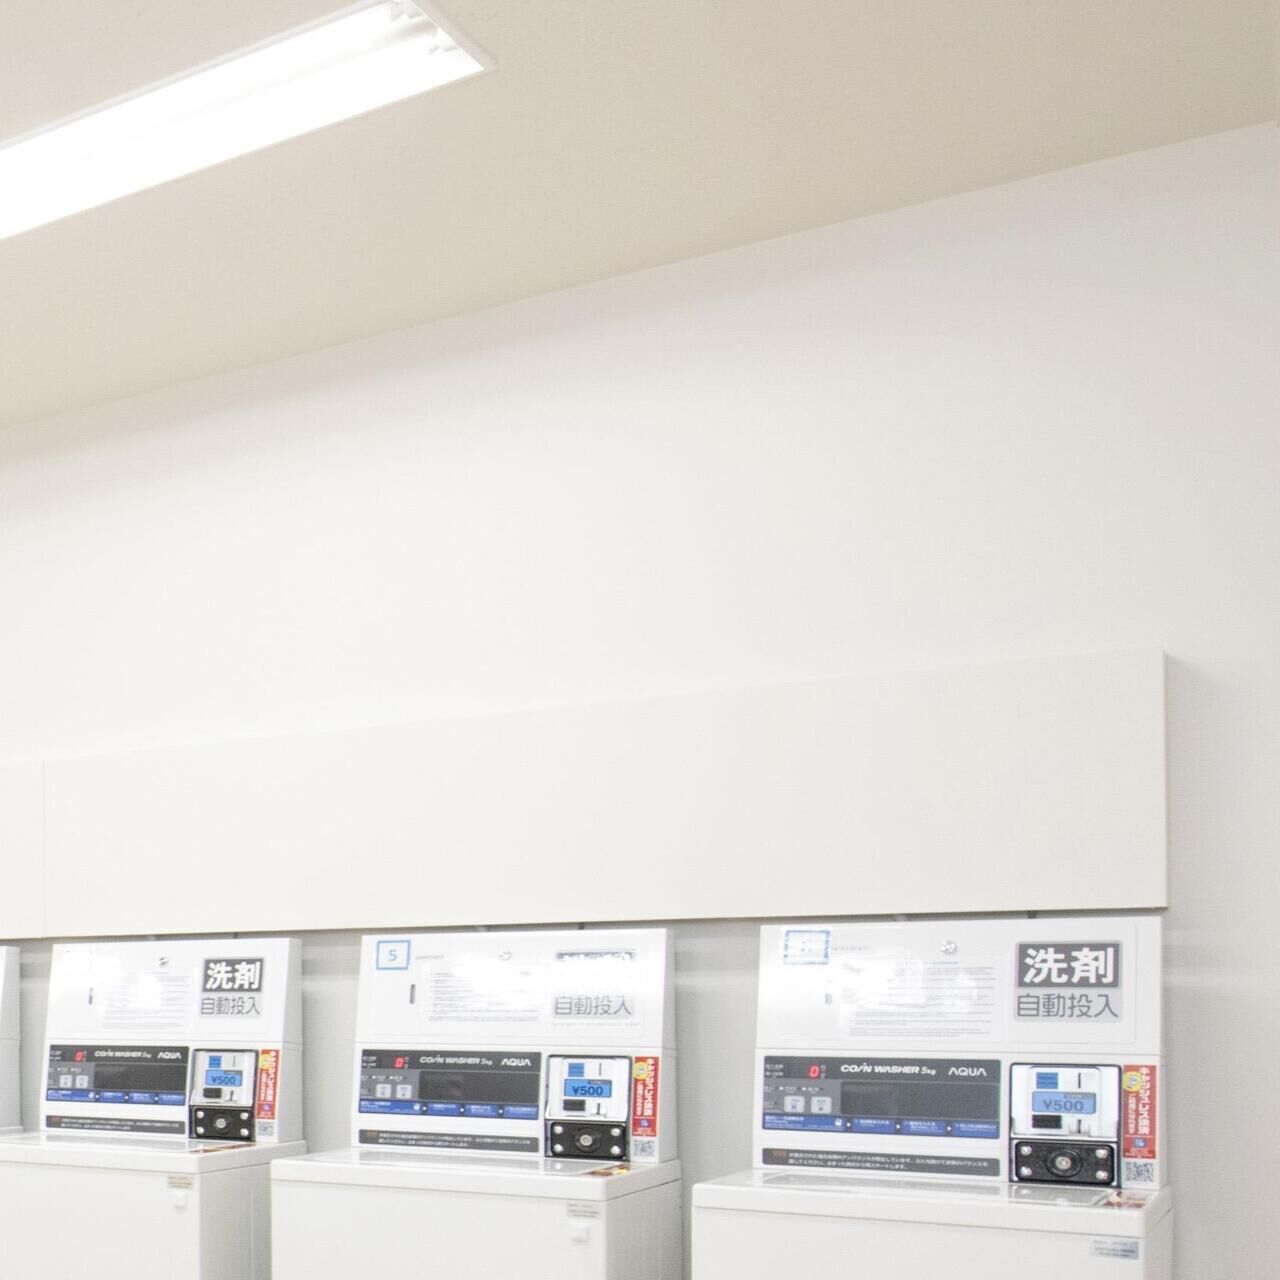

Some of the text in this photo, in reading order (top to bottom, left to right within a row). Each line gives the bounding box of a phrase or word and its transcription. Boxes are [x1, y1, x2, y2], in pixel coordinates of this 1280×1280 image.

[388, 949, 397, 961] 5
[1023, 946, 1115, 984] 洗剤
[205, 961, 262, 990] 洗剤
[200, 996, 261, 1016] 自動投入
[554, 996, 632, 1016] 自動投入
[1016, 993, 1119, 1018] 自動投入
[157, 1051, 182, 1060] AQUA
[445, 1057, 481, 1065] WASHER
[501, 1058, 532, 1067] AQUA
[808, 1064, 819, 1078] 0
[874, 1065, 919, 1074] WASHER
[948, 1067, 987, 1077] AQUA
[211, 1075, 236, 1086] ¥500
[572, 1086, 604, 1096] ¥500
[1043, 1099, 1085, 1112] ¥500
